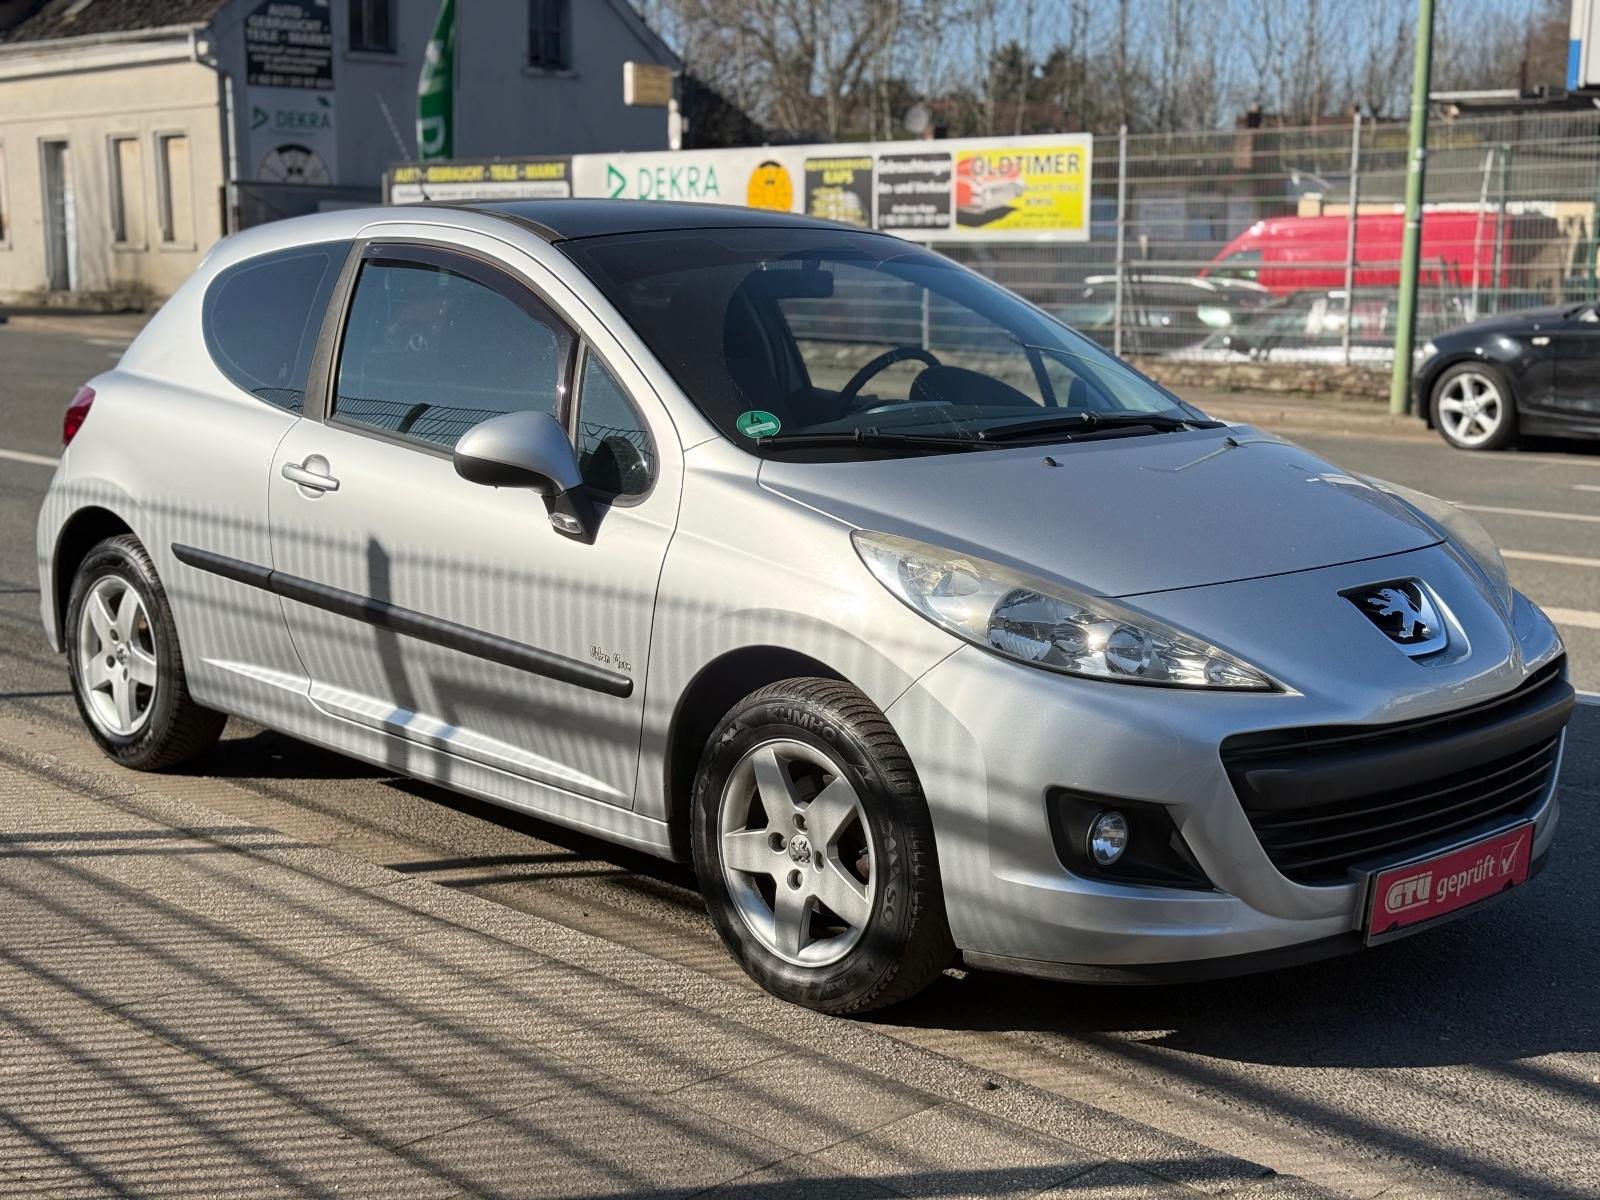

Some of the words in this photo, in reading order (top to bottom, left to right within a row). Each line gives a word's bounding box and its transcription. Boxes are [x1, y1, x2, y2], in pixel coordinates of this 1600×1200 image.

[276, 109, 332, 130] DEKRA
[970, 153, 1081, 176] OLDTIMER
[638, 165, 721, 200] DEKRA
[750, 412, 763, 425] 4
[766, 706, 839, 741] KUMHO
[1387, 872, 1432, 909] GTÜ
[1436, 854, 1496, 904] geprüft
